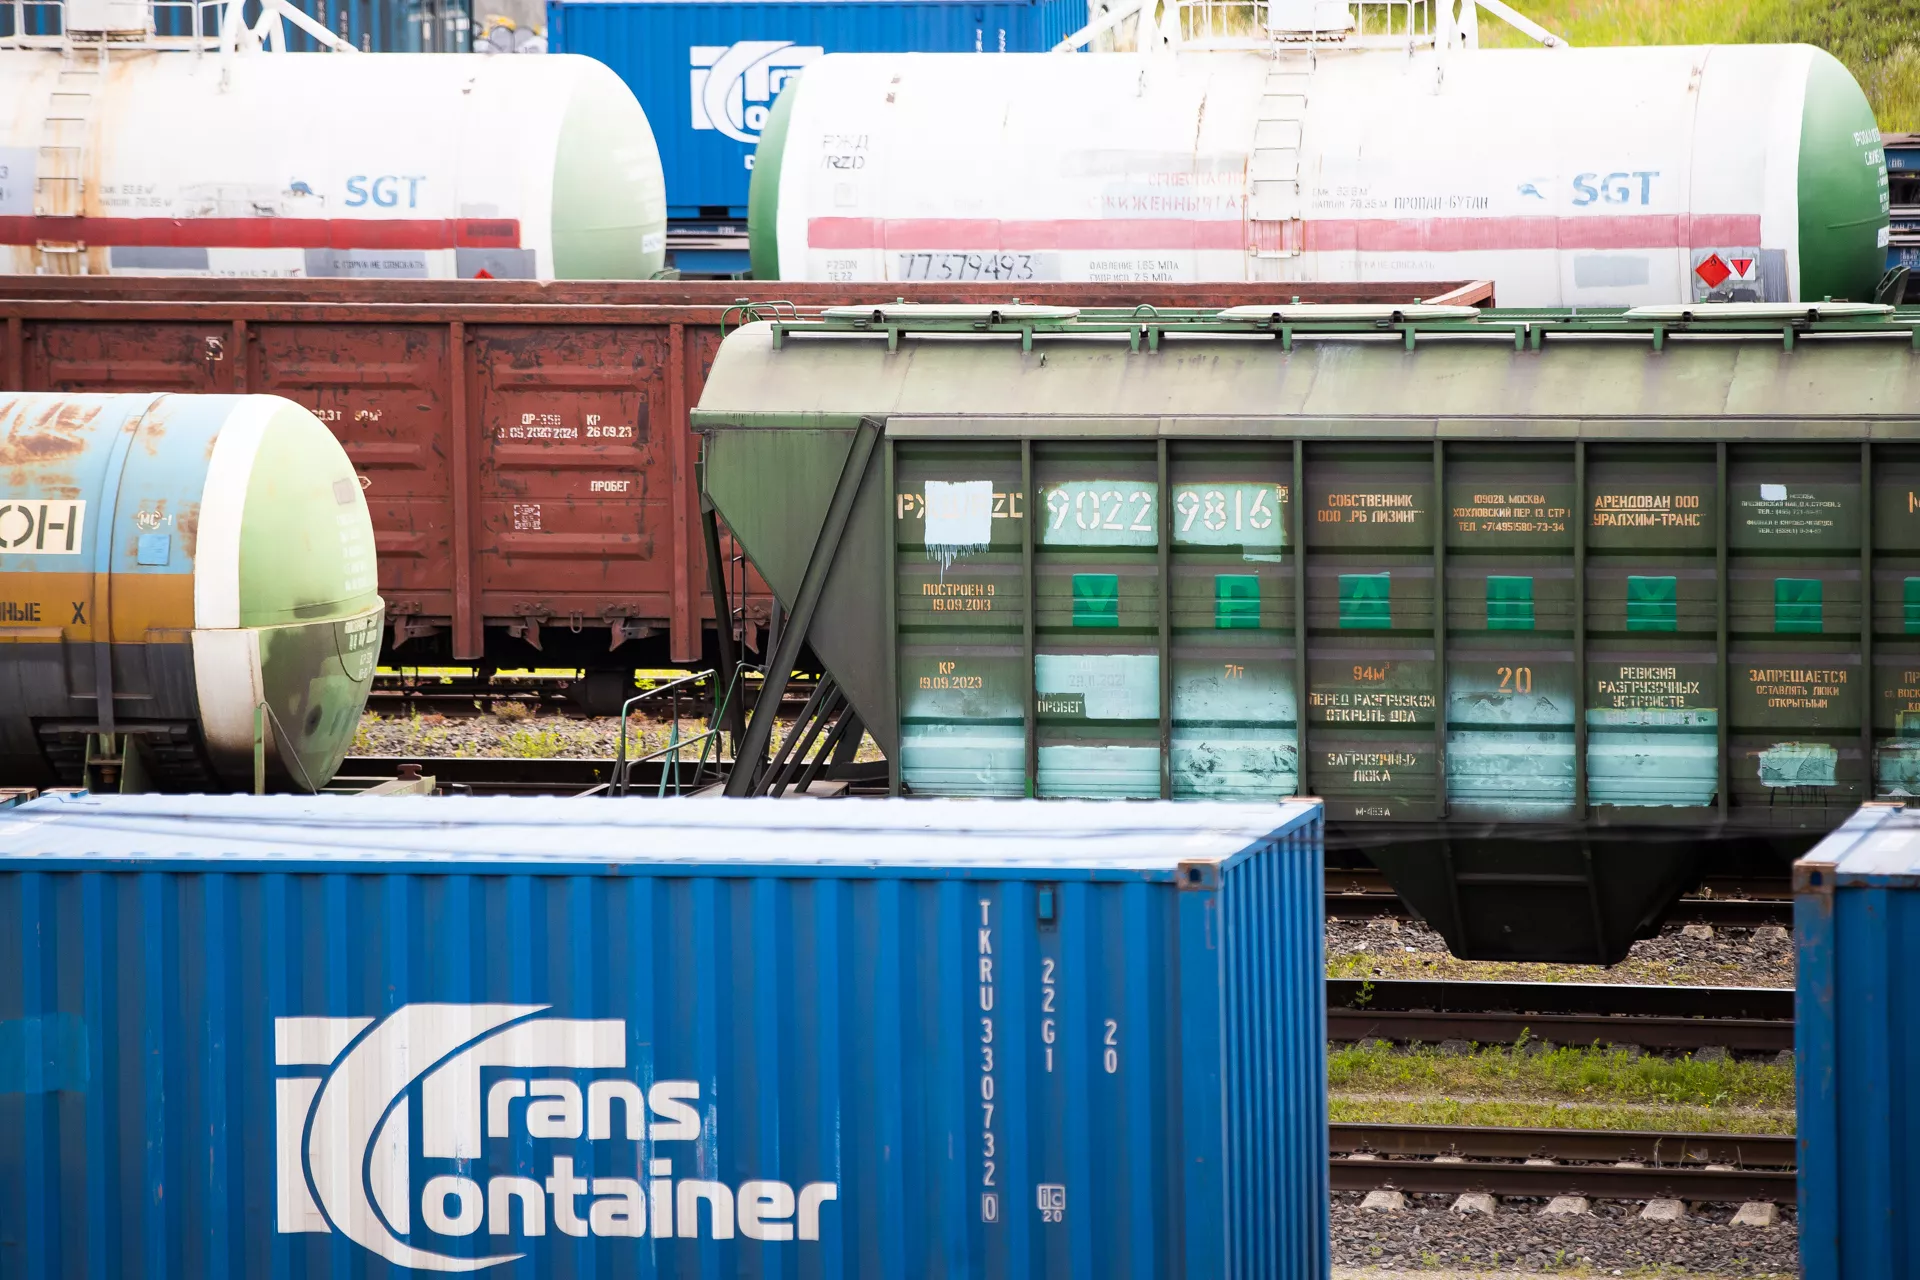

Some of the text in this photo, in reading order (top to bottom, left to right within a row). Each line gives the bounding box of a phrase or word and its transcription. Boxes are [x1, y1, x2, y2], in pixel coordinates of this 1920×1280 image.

[345, 175, 427, 208] SGT
[1572, 171, 1660, 206] SGT
[587, 414, 601, 426] КР
[553, 427, 578, 439] 2024
[591, 481, 630, 492] ПРОБЕГ
[1328, 494, 1413, 507] СОБСТВЕННИК
[1508, 494, 1547, 504] МОСКВА
[1594, 495, 1699, 508] АРЕНДОВАН ООО
[1047, 489, 1273, 532] 9022 9816
[1317, 510, 1341, 522] ООО
[1453, 507, 1512, 518] ХОХЛОВСКИЙ
[922, 583, 984, 596] ПОСТРОЕН
[939, 662, 956, 674] КР
[1620, 667, 1676, 680] РЕВИЗИЯ
[1497, 667, 1532, 693] 20
[1749, 669, 1847, 684] ЗАПРЕЩАЕТСЯ
[1598, 680, 1700, 694] РАЗГРУЗОЧНЫХ
[1756, 685, 1840, 696] ОСТАВЛЯТЬ ЛЮКИ
[1310, 693, 1350, 706] ПЕРЕД
[1767, 698, 1828, 709] ОТКРЫТЫМИ
[1037, 700, 1083, 713] ПРОБЕГ
[1325, 709, 1417, 723] ОТКРЫТЬ ДВА
[1353, 769, 1392, 782] ЛЮКА
[977, 899, 994, 1012] TKRU
[1043, 1210, 1063, 1222] 20
